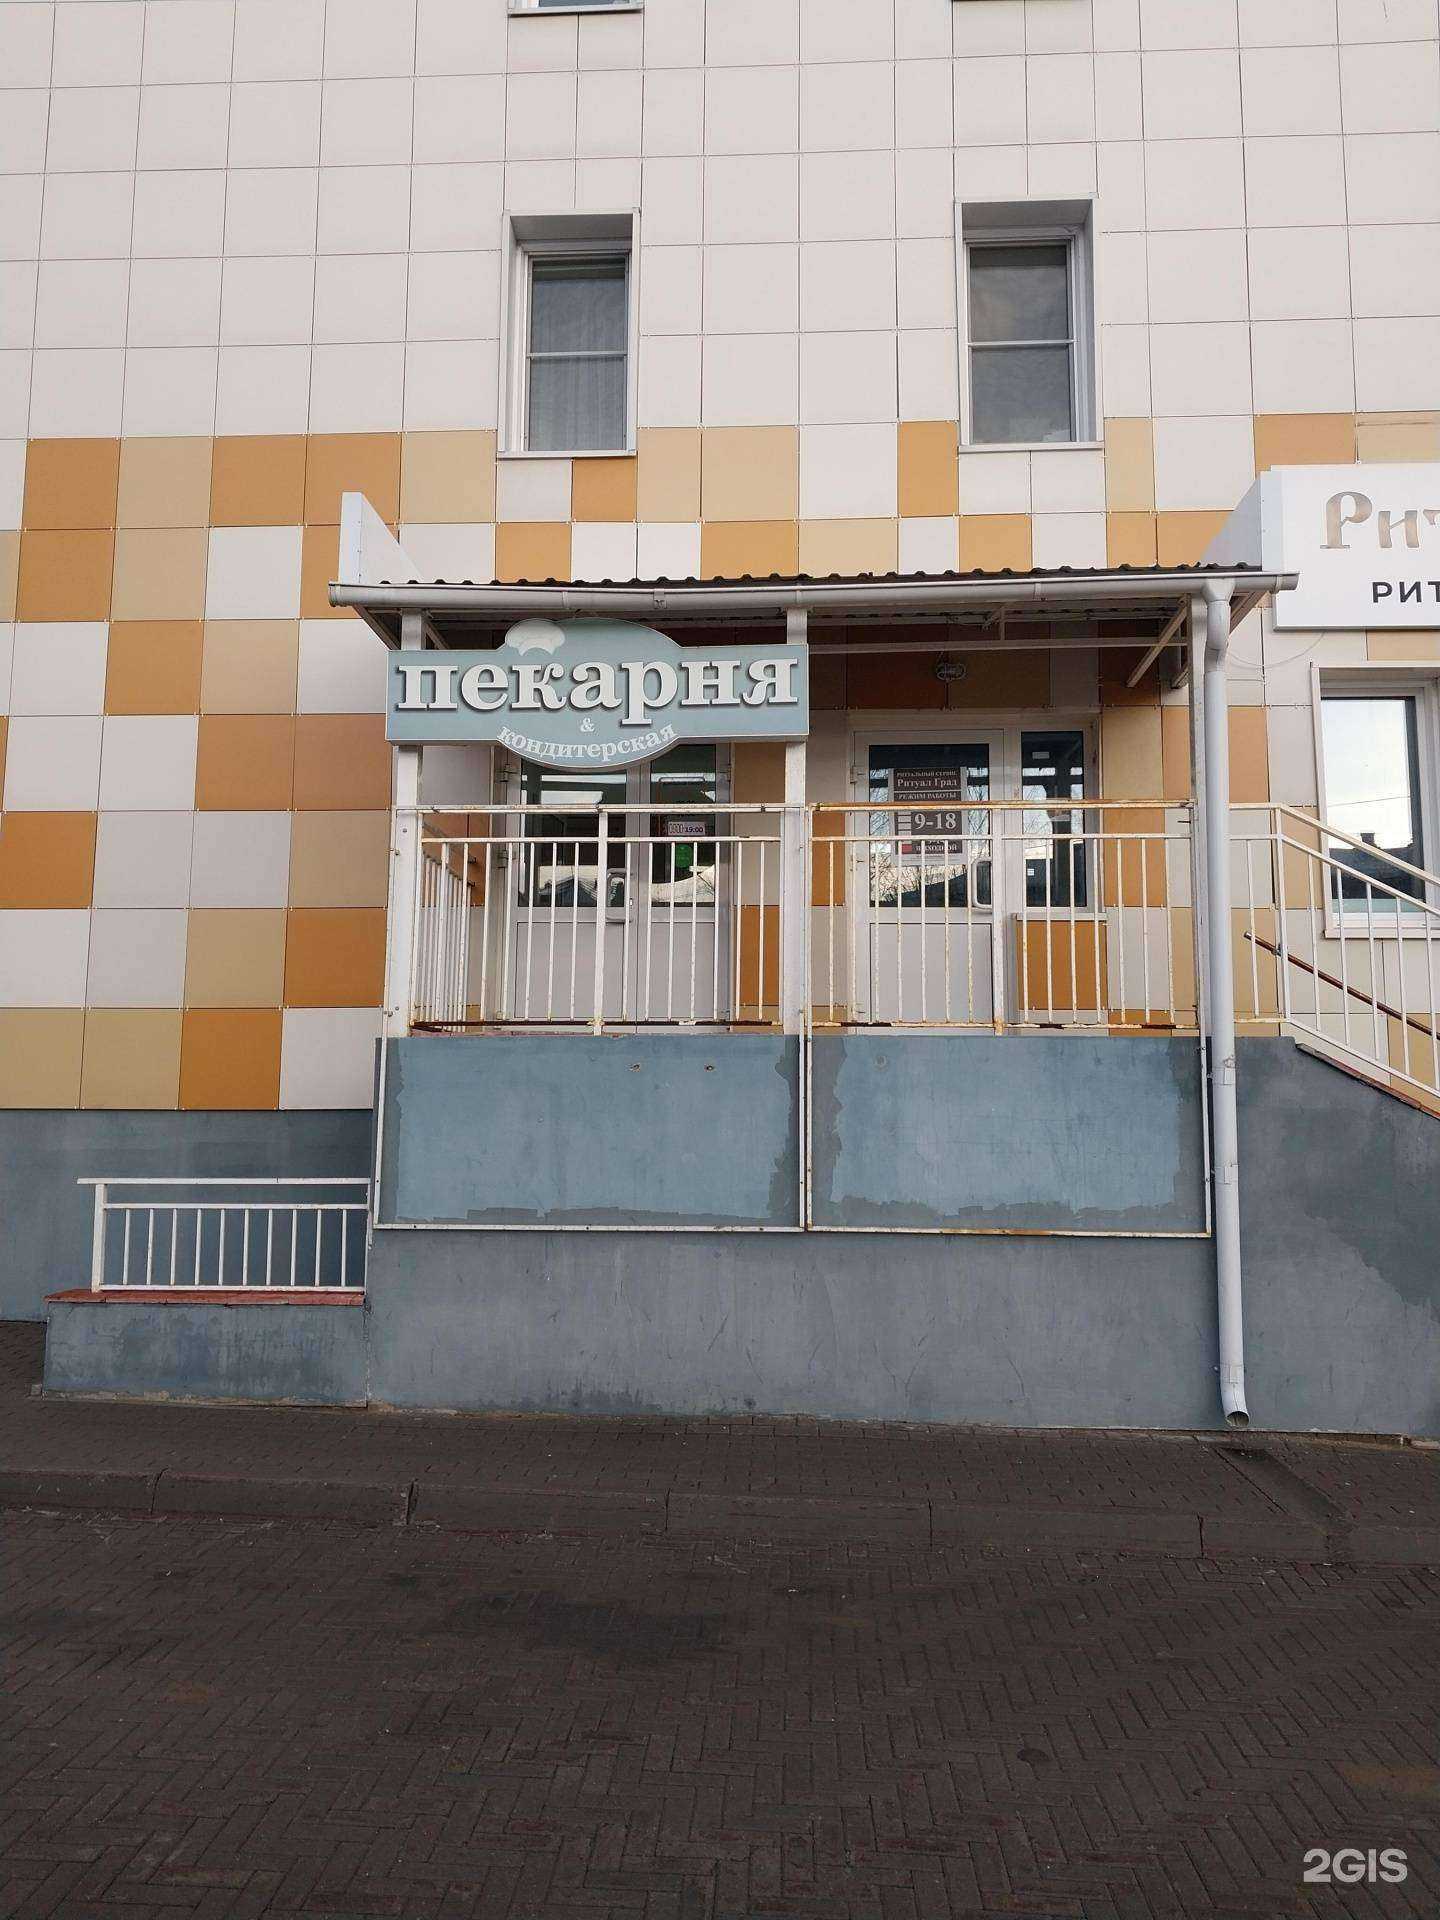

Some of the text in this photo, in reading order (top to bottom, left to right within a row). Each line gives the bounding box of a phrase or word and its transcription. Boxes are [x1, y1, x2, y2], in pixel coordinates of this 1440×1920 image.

[1372, 581, 1440, 603] РИТ
[397, 658, 799, 727] пекарня
[580, 717, 595, 732] &
[497, 724, 679, 762] кондитерская
[897, 778, 957, 788] Ритуал Град
[914, 812, 957, 829] 9-18
